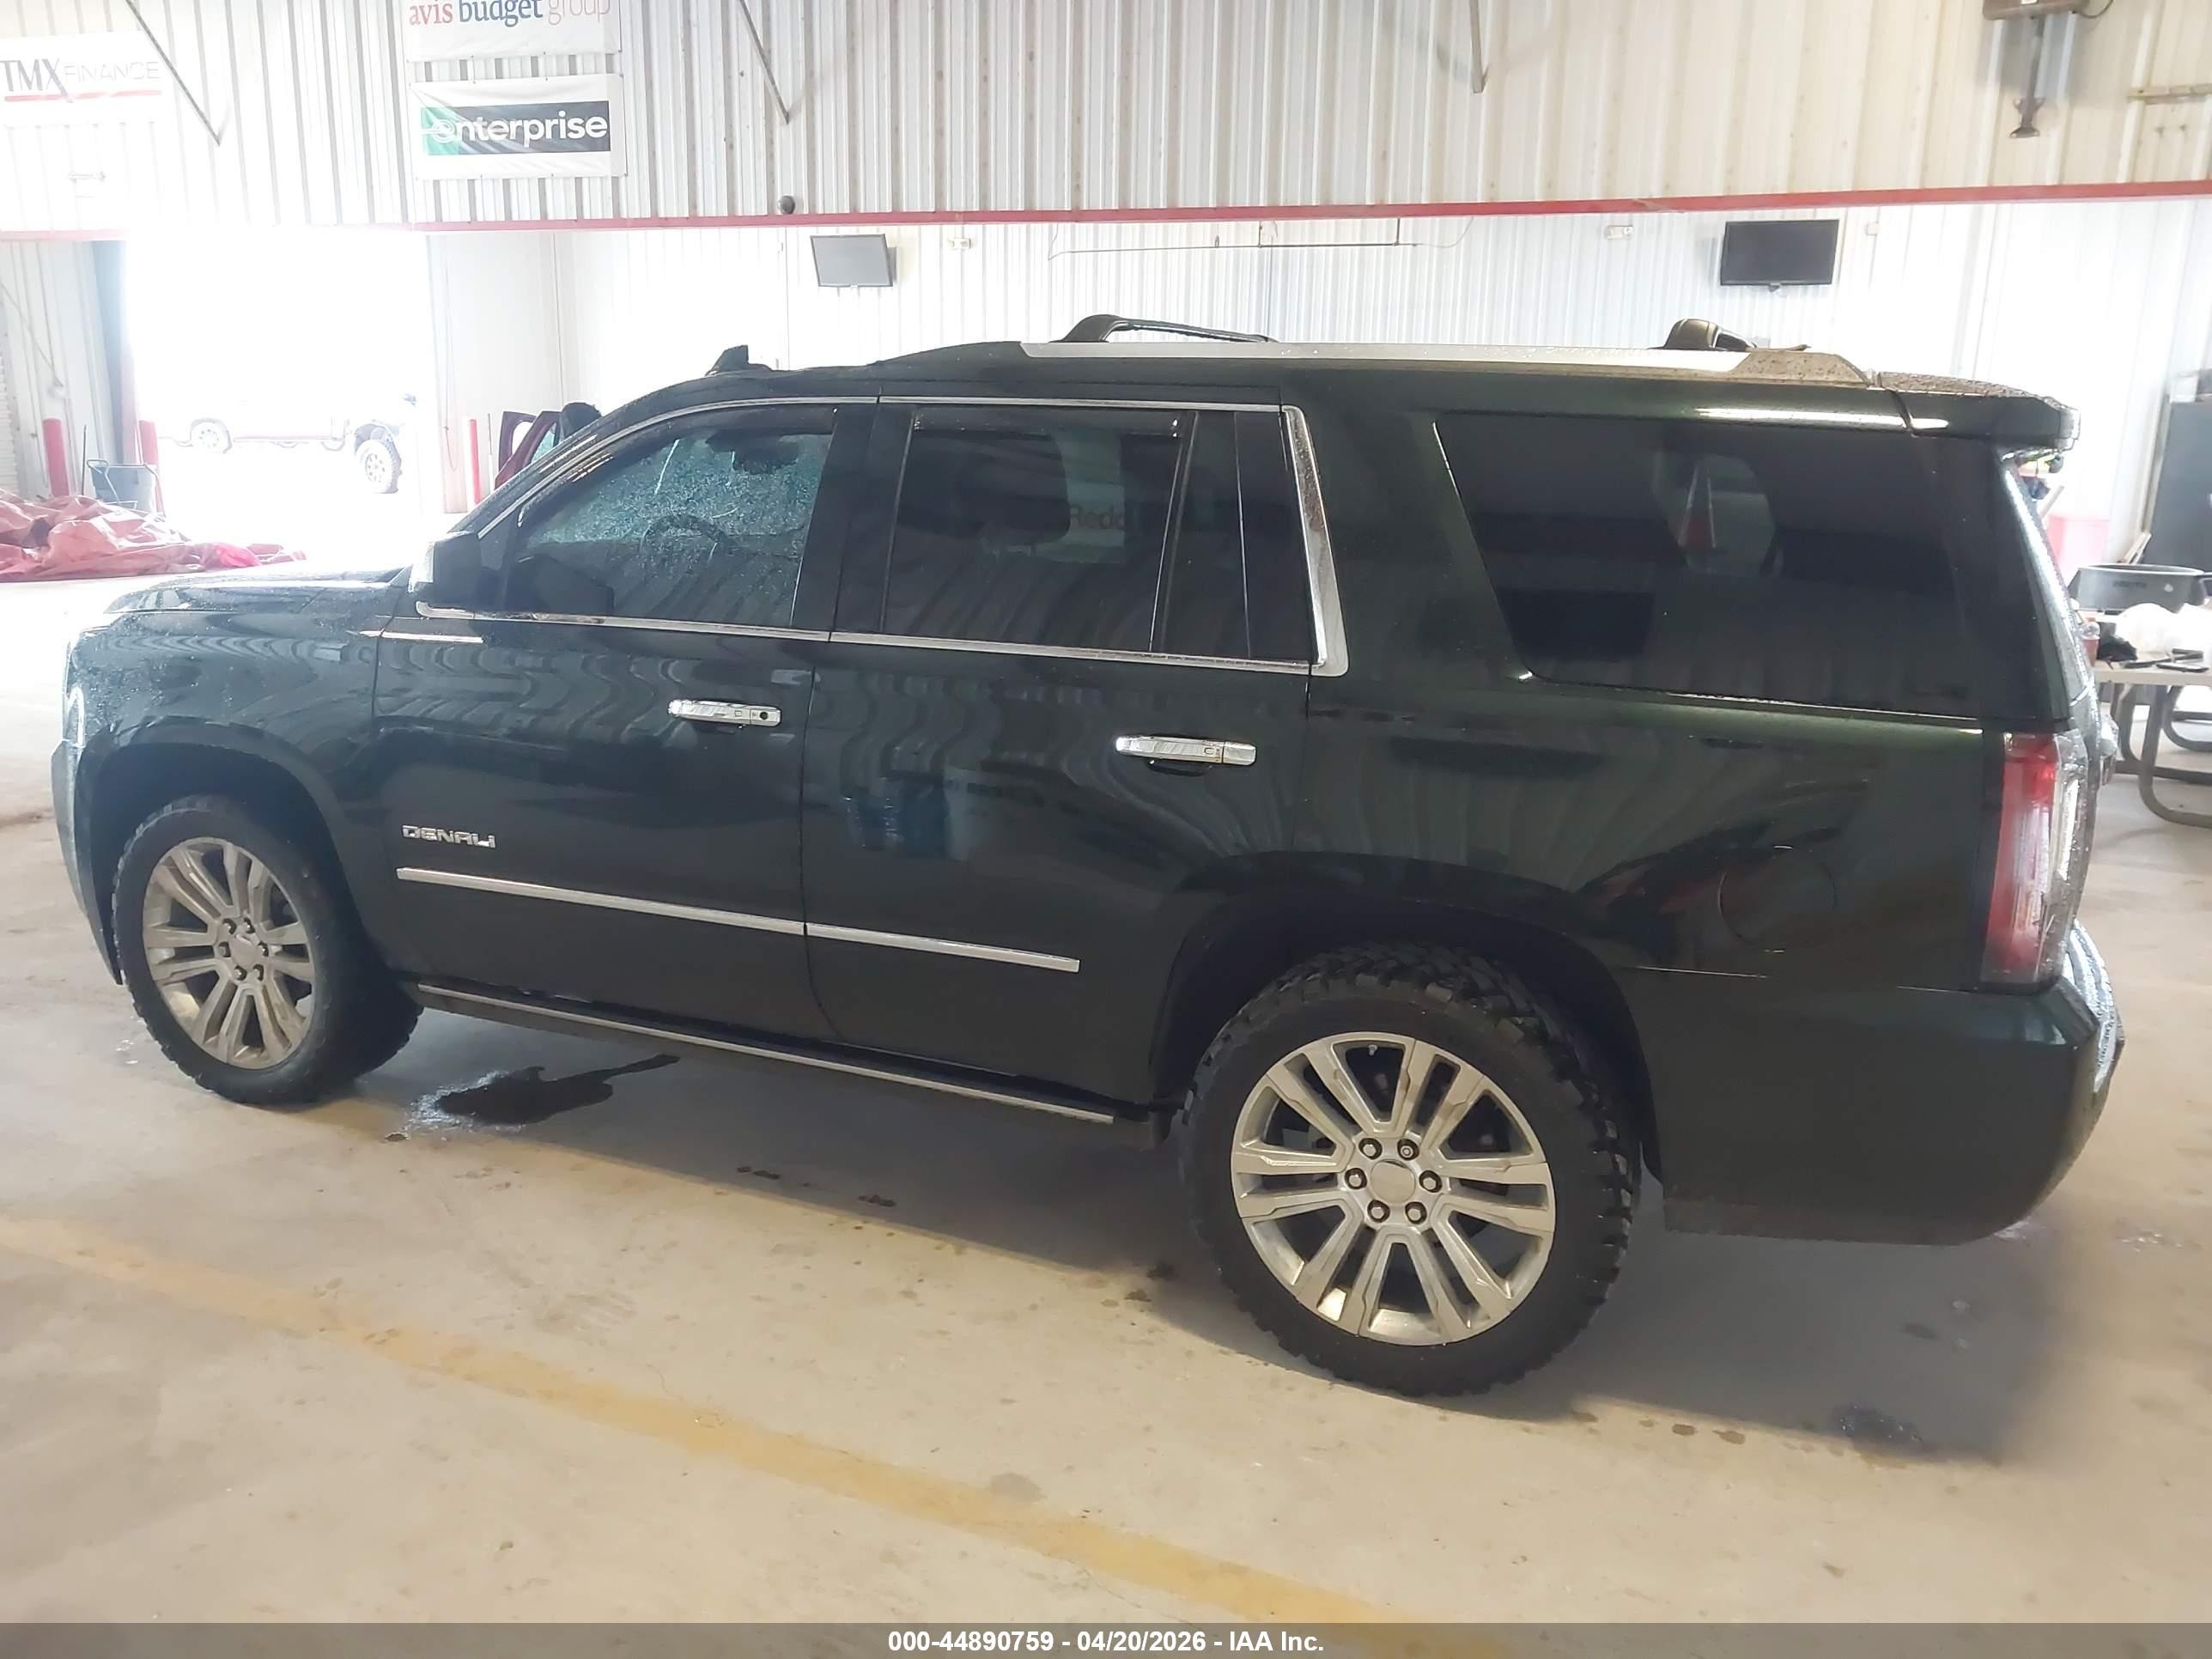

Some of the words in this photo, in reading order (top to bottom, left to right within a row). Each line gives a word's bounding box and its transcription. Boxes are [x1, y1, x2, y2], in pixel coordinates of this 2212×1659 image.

[409, 2, 453, 26] avis
[459, 0, 544, 27] budget
[548, 0, 611, 26] group
[0, 58, 73, 103] TMX
[64, 61, 161, 83] FINANCE
[428, 110, 609, 148] enterprise
[402, 825, 495, 848] DENALI
